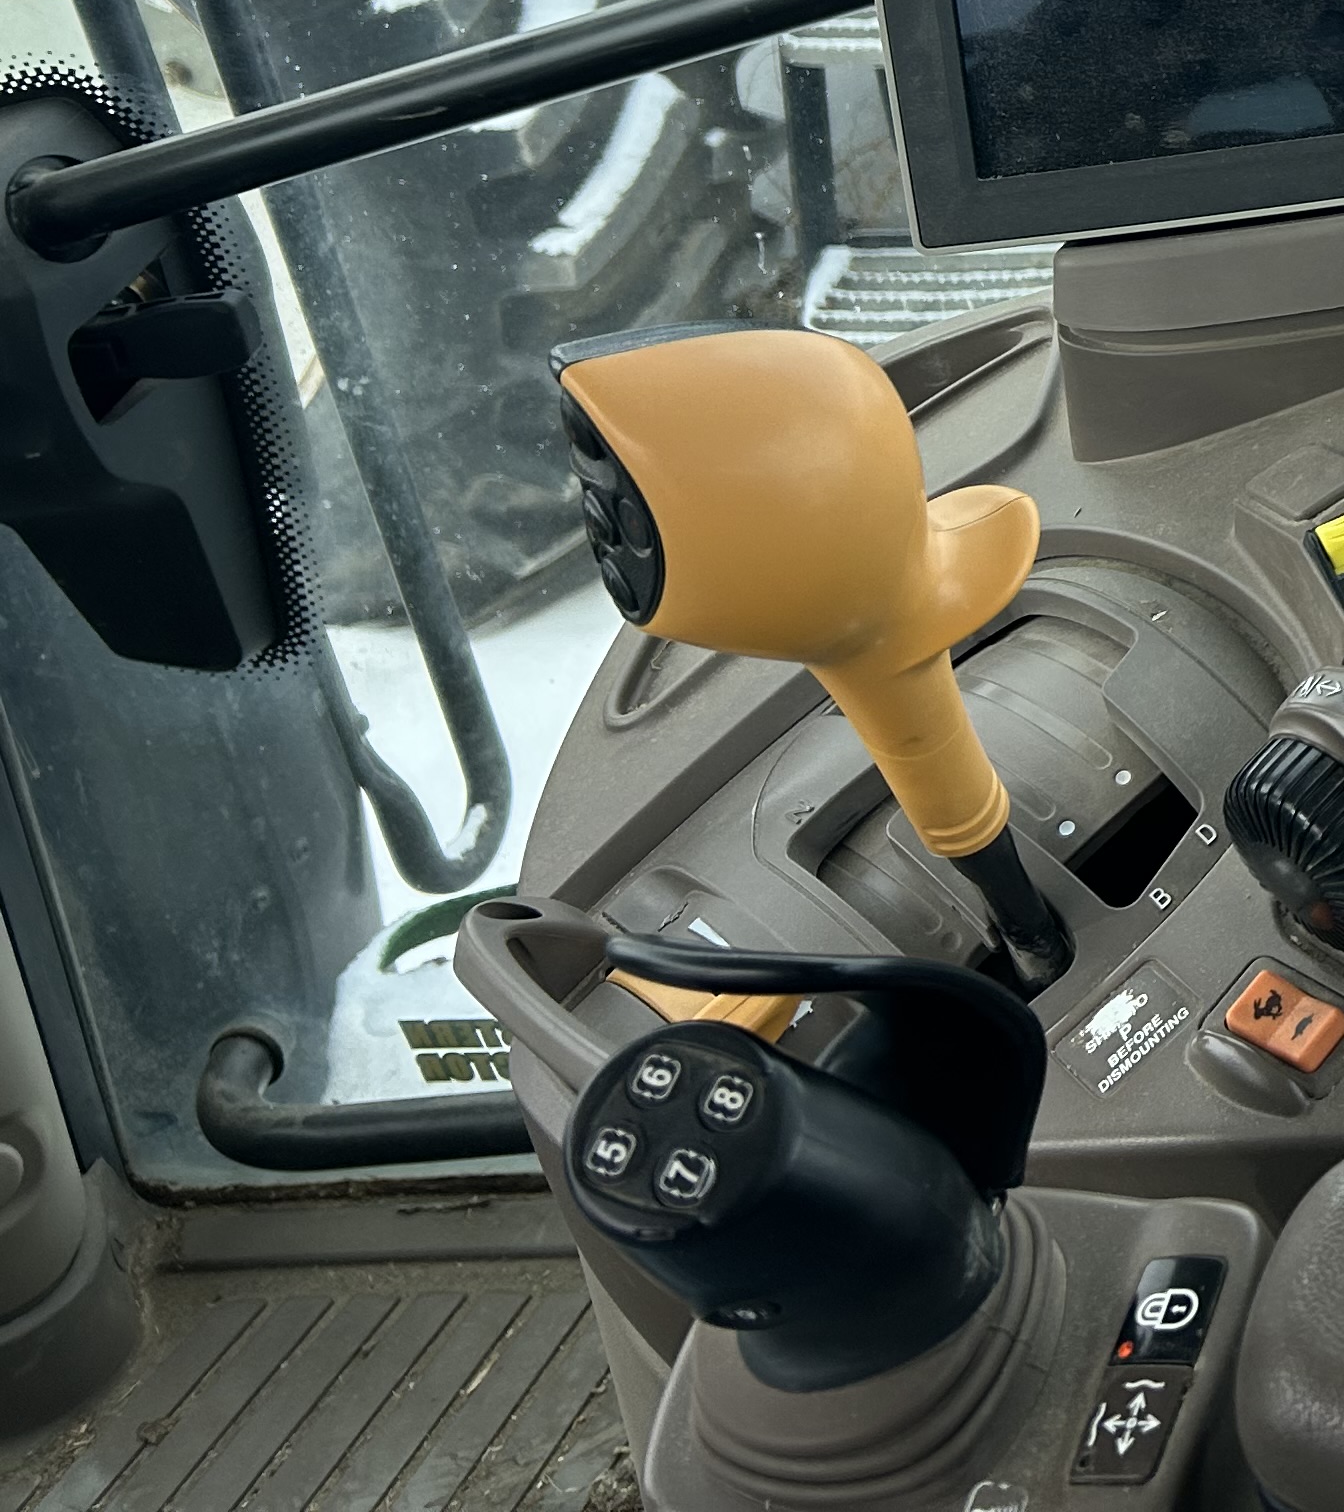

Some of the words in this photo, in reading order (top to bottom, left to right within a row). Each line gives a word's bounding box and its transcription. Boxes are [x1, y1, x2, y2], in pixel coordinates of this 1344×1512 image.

[1195, 823, 1218, 846] D
[1149, 887, 1172, 910] B
[1107, 1013, 1164, 1068] BEFORE
[1118, 1022, 1132, 1042] P
[1097, 1007, 1190, 1094] DISMOUNTING
[641, 1066, 672, 1086] 6
[713, 1086, 745, 1111] 8
[597, 1140, 627, 1163] 5
[668, 1160, 700, 1184] 7
